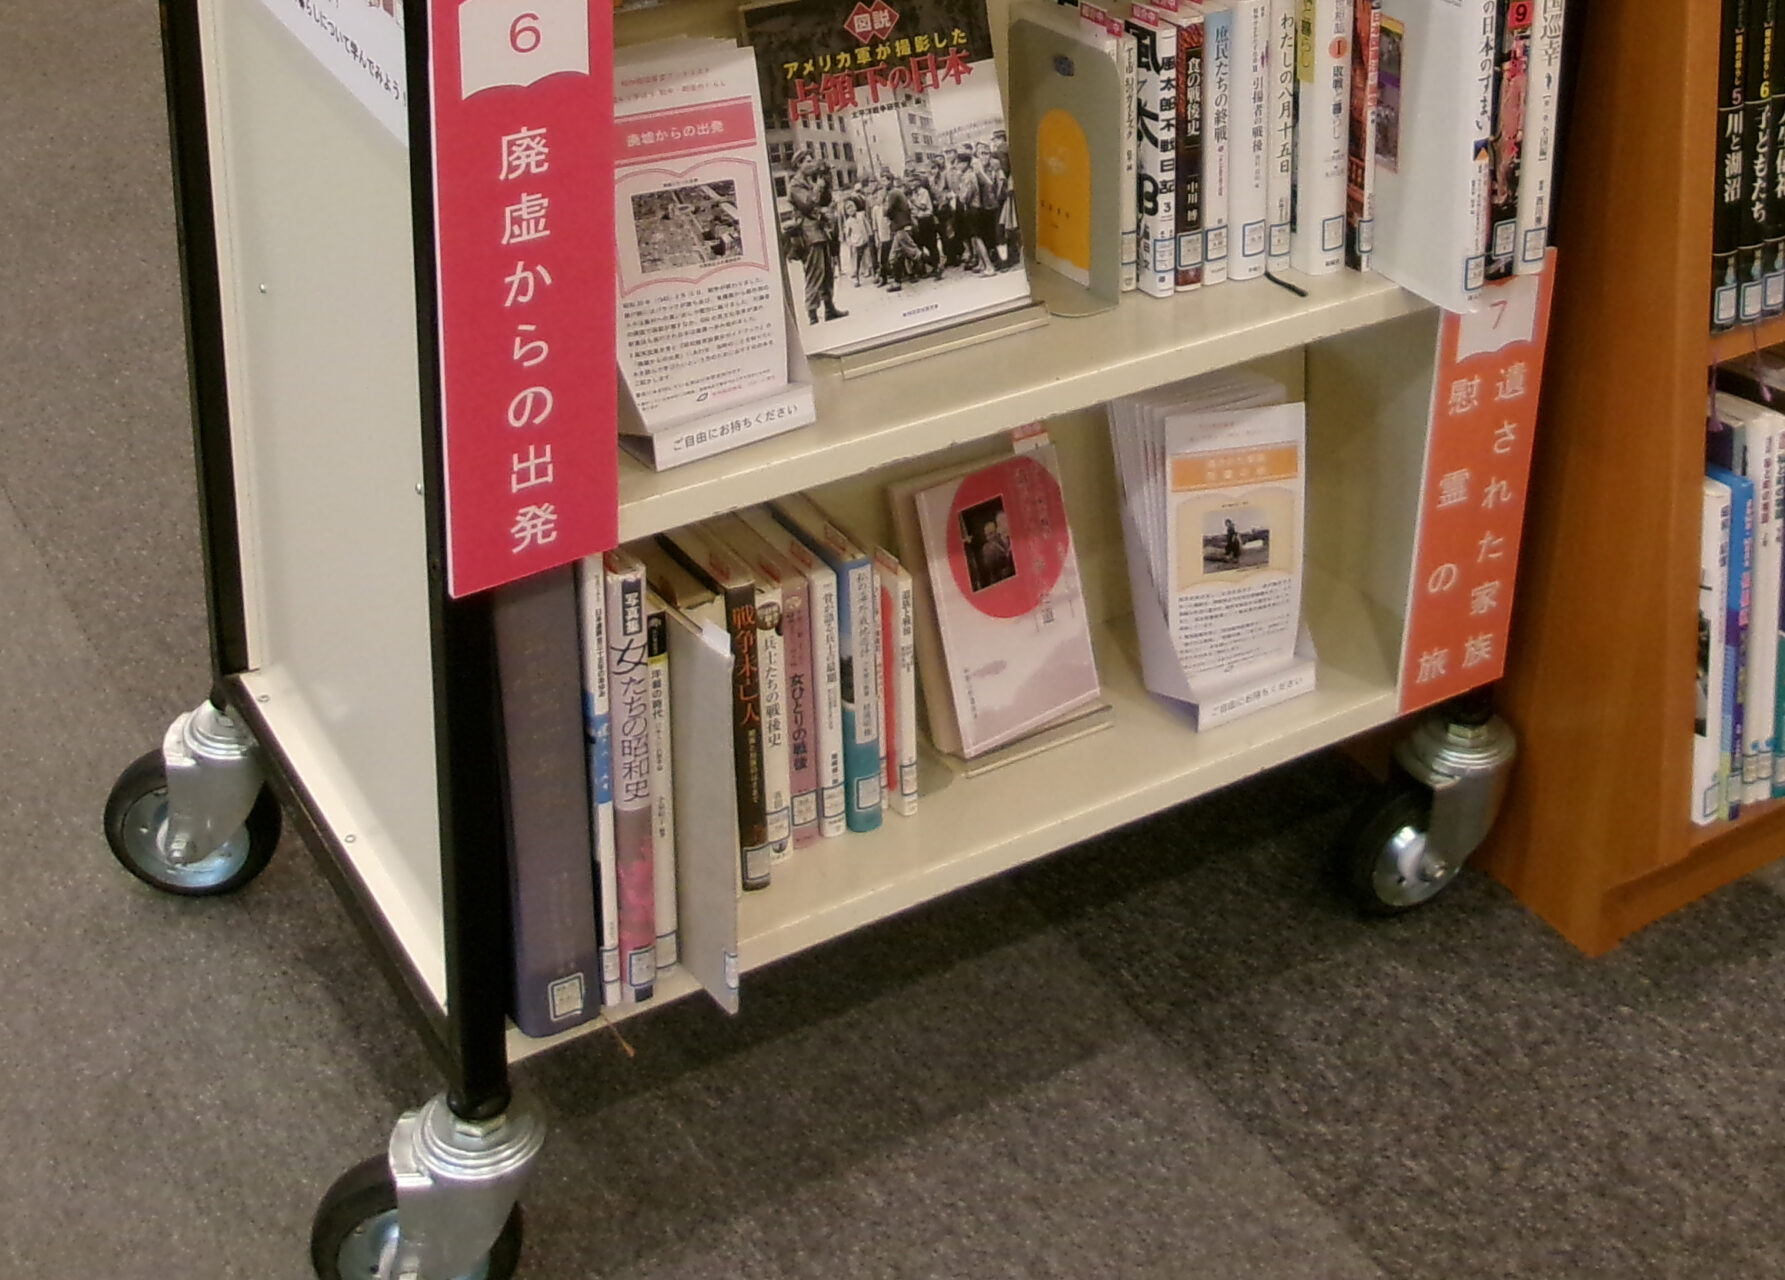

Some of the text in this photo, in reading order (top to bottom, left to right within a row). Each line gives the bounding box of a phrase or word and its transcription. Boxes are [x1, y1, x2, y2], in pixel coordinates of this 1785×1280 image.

[507, 11, 543, 55] 6
[784, 28, 968, 80] アメリカ軍が撮影した
[853, 8, 892, 33] 図説
[1514, 3, 1528, 22] 9
[788, 47, 974, 123] 占領下の日本
[1186, 56, 1202, 138] 食の戦後史
[1213, 24, 1229, 142] 庶民たちの終戦
[1277, 12, 1295, 174] わたしの八月十五日
[1732, 86, 1743, 106] 5
[1759, 80, 1771, 99] 6
[1159, 55, 1177, 213] 風太郎不戦日記 3
[1723, 111, 1744, 204] 川と湖沼
[1751, 105, 1773, 224] 子どもたち
[497, 124, 559, 556] 廃虚からの出発
[1488, 300, 1508, 331] 7
[672, 402, 799, 452] ご自由にお持ちください
[1415, 376, 1482, 685] 慰霊の旅
[1461, 360, 1529, 670] 遺された家族
[624, 592, 641, 635] 写真集
[732, 604, 762, 726] 戦争未亡人
[763, 635, 783, 747] 兵士たちの戦後史
[610, 638, 652, 804] 女たちの昭和史
